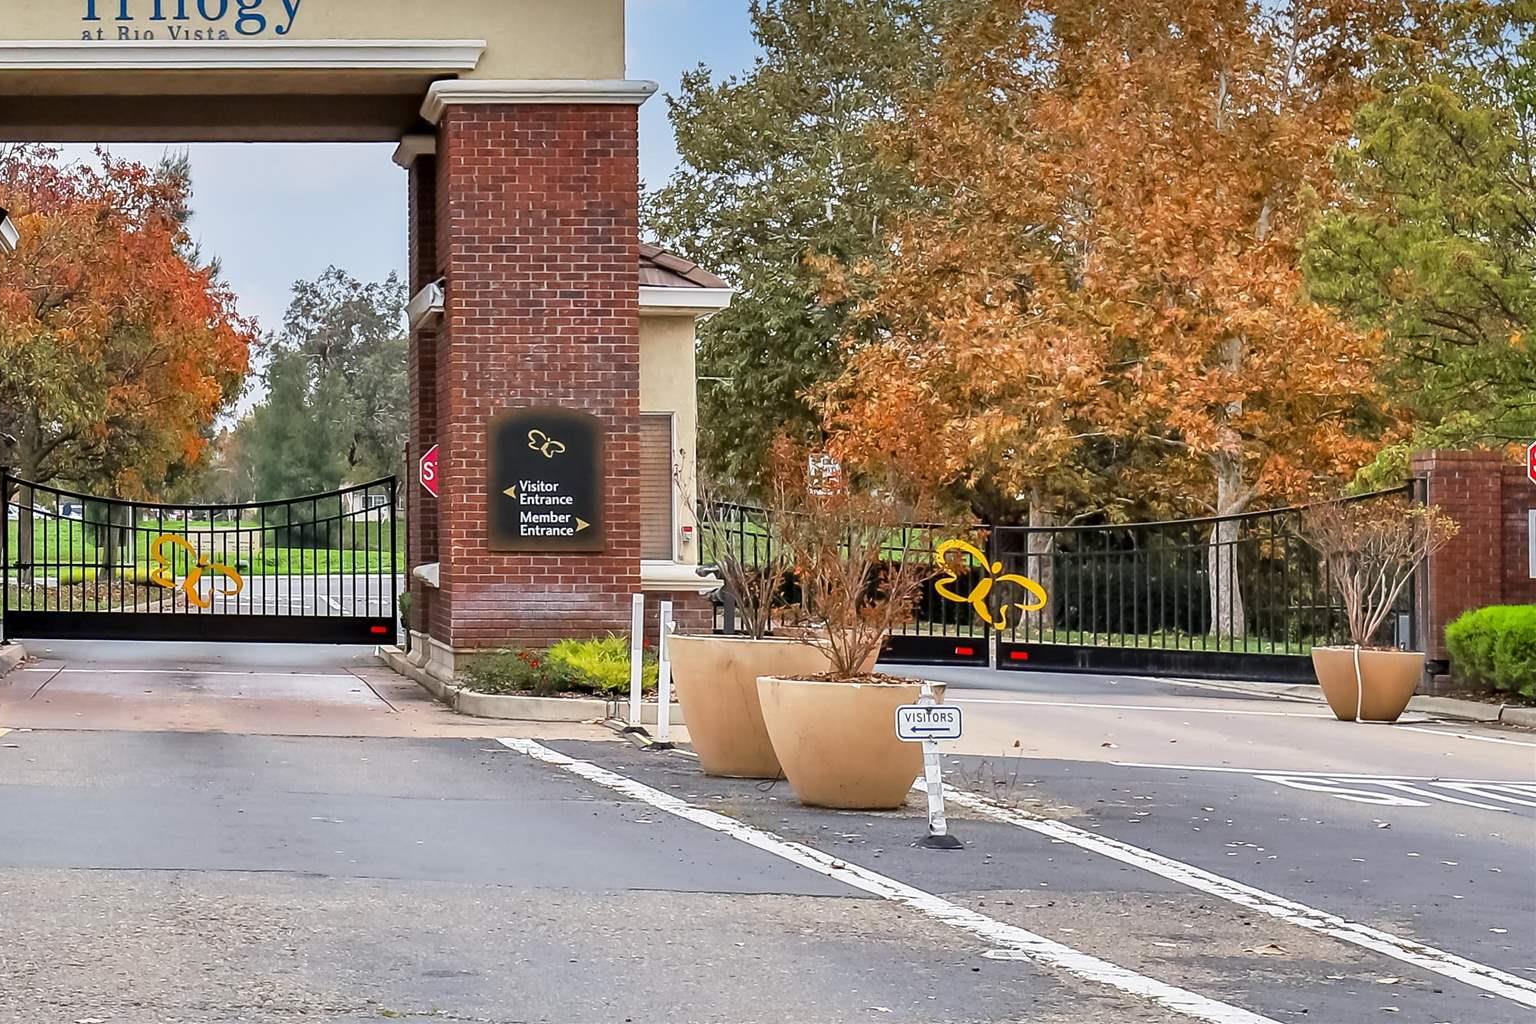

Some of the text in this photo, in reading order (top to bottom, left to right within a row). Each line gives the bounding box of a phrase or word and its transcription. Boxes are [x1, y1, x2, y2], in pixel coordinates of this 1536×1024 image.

[81, 25, 230, 41] at Rio Vista
[519, 480, 559, 493] Visitor
[519, 494, 573, 505] Entrance
[520, 511, 572, 524] Member
[520, 525, 574, 537] Entrance
[904, 712, 954, 723] VISITORS
